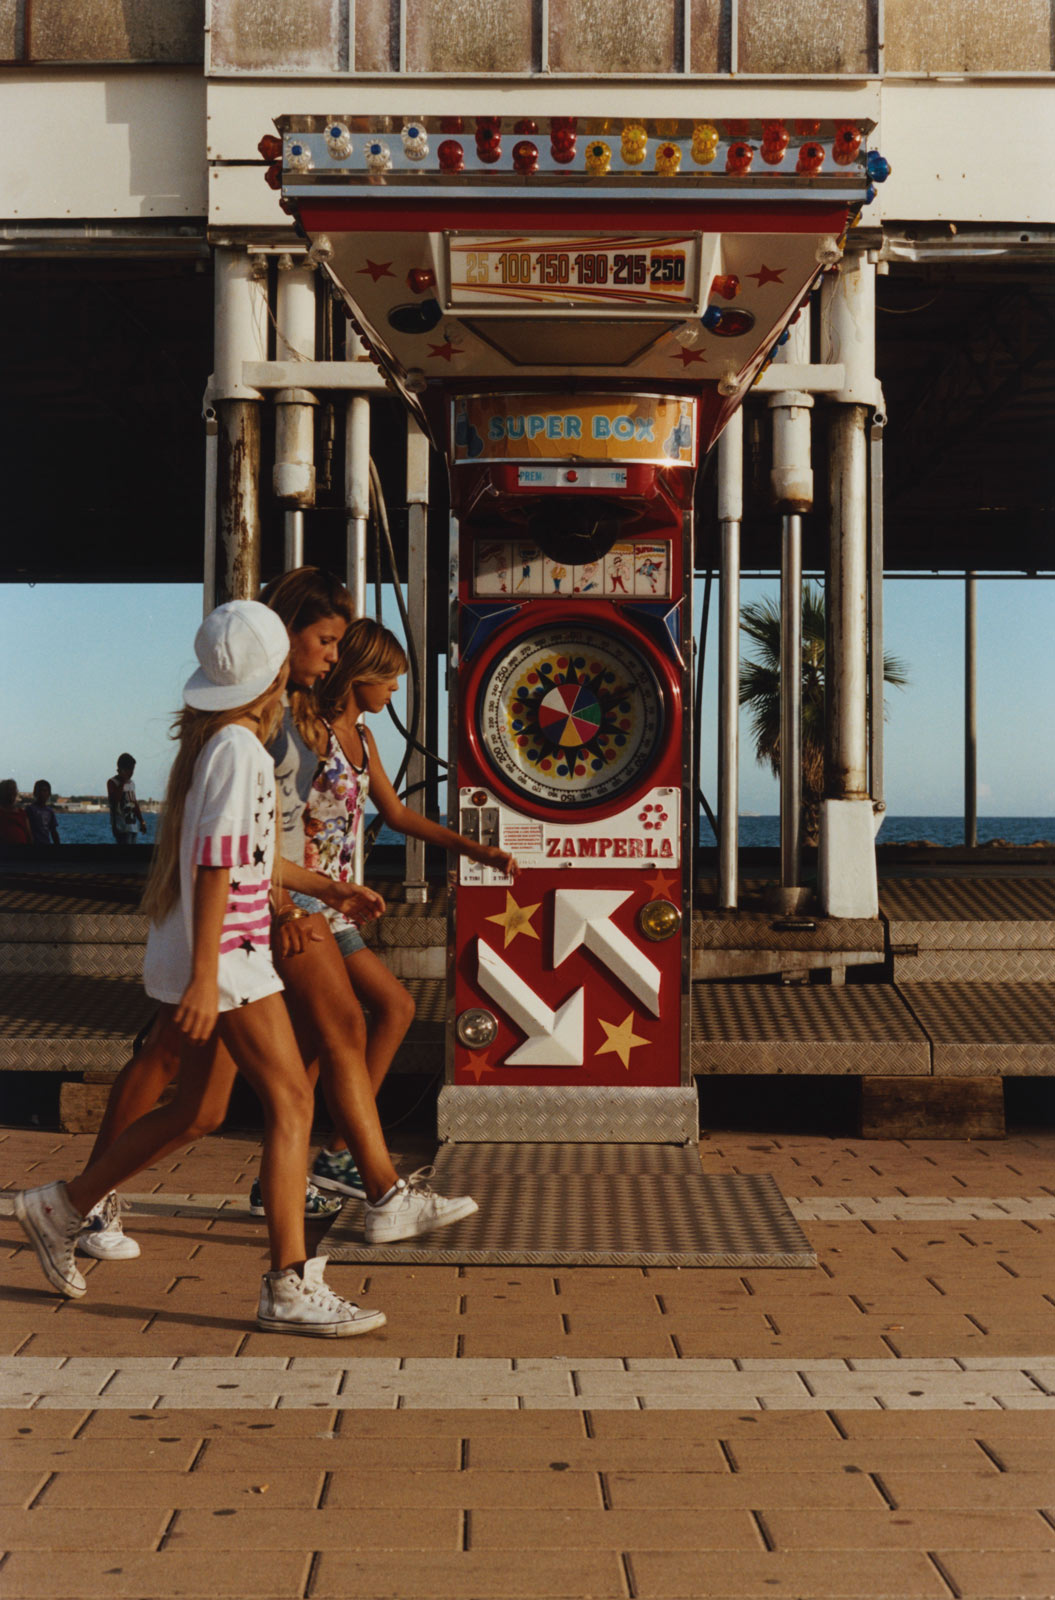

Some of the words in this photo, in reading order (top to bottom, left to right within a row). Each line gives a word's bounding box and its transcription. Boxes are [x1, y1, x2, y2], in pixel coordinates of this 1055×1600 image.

[466, 253, 489, 283] 25
[498, 253, 531, 284] 100
[536, 253, 570, 284] 150
[574, 254, 608, 284] 190
[613, 254, 647, 284] 215
[650, 256, 685, 284] 250
[488, 415, 582, 440] SUPER
[592, 415, 656, 442] BOX
[495, 666, 508, 683] 250
[491, 684, 499, 697] 240
[493, 747, 506, 763] 200
[561, 793, 576, 802] 150
[546, 838, 674, 858] ZAMPERLA
